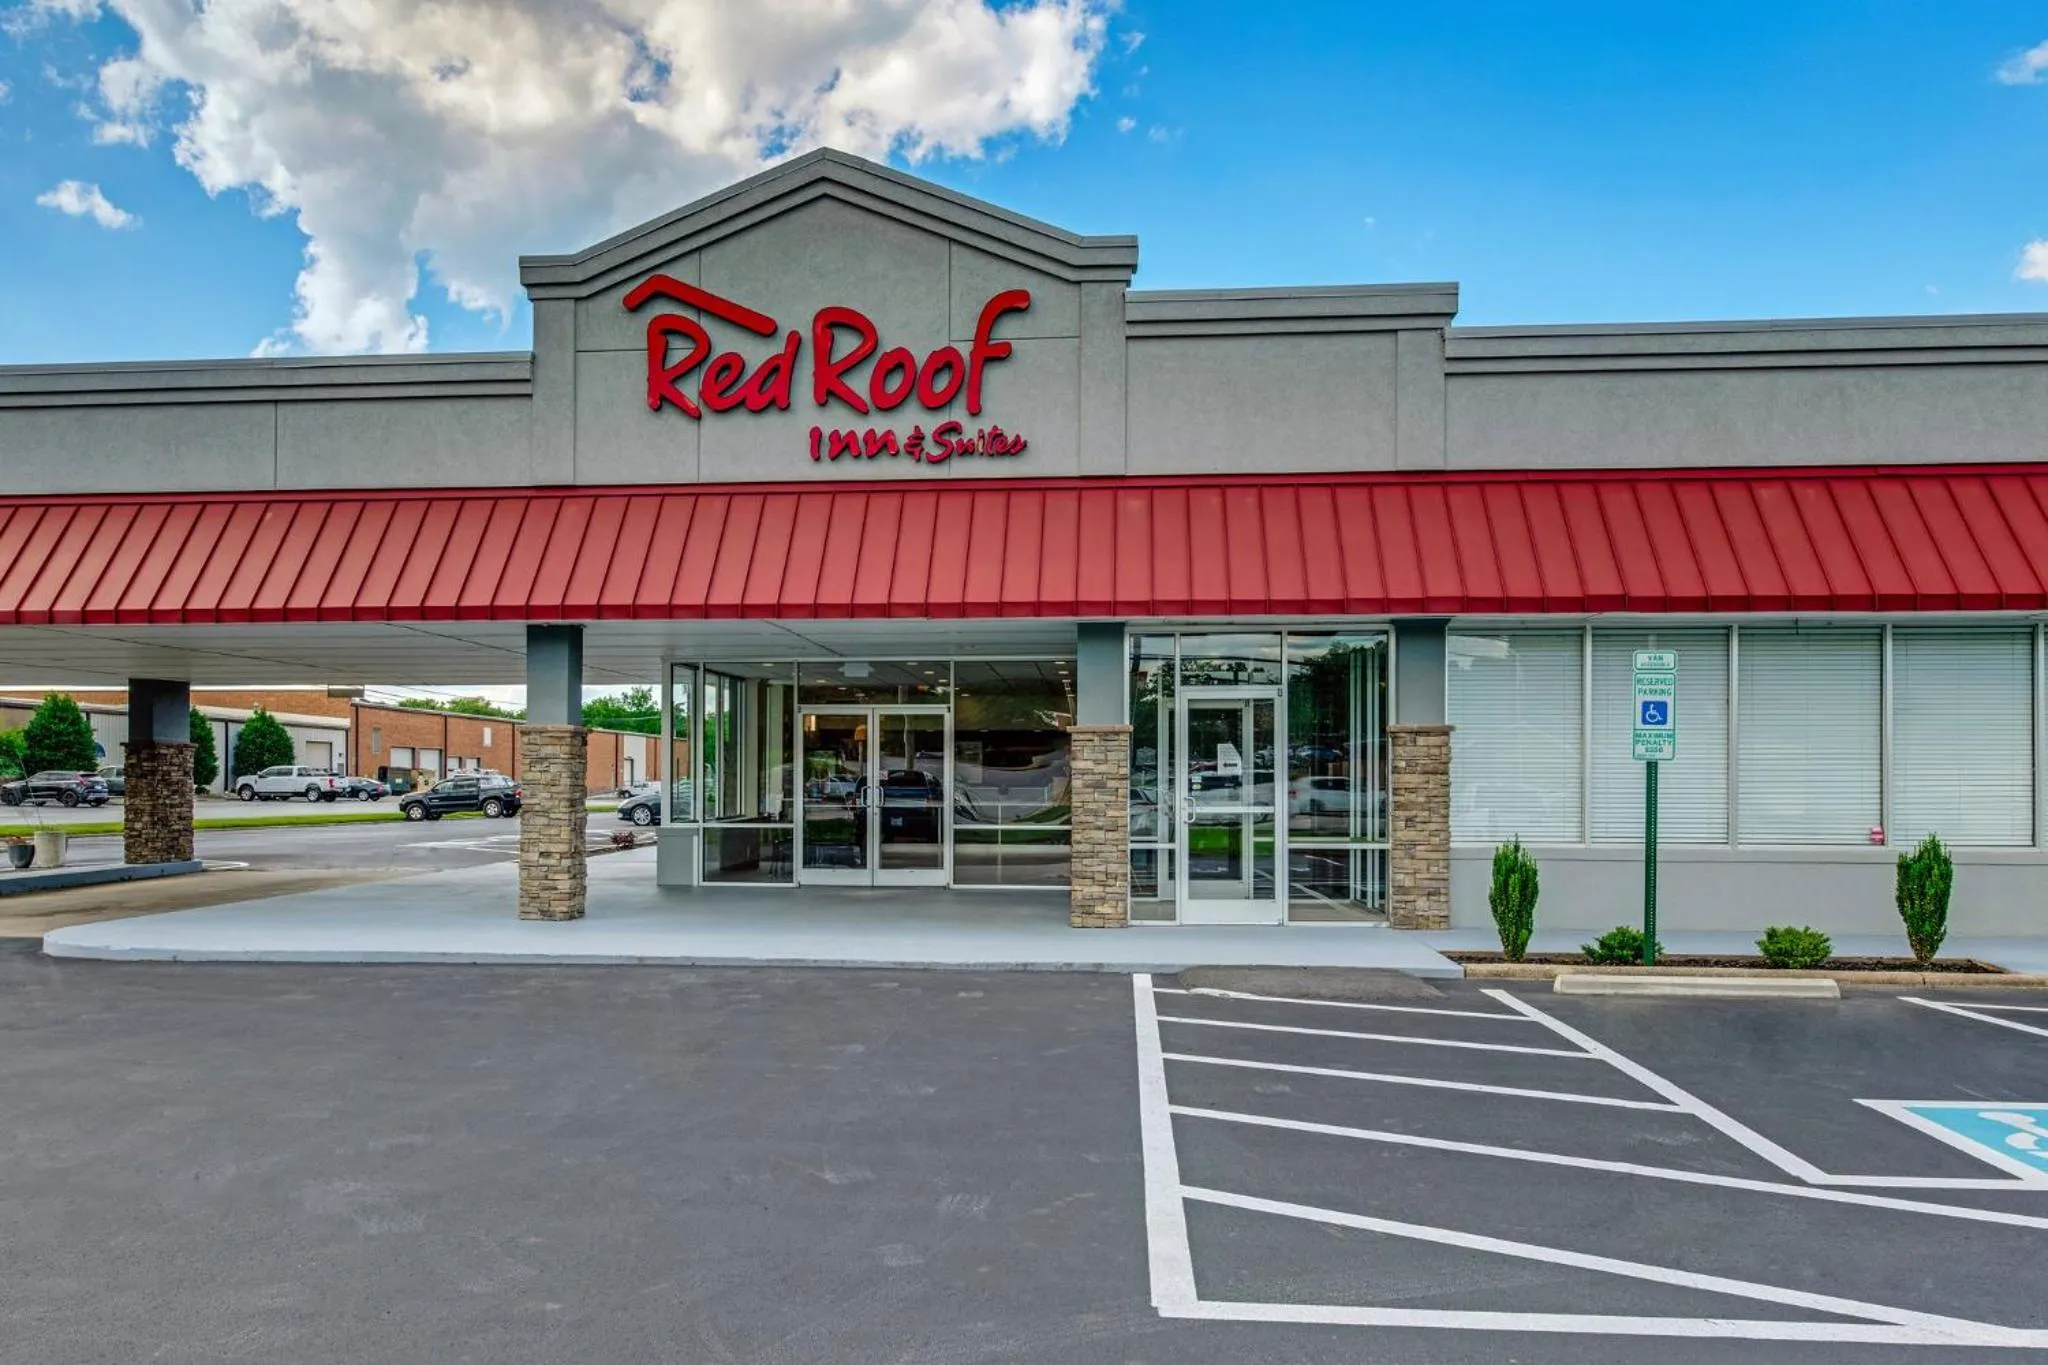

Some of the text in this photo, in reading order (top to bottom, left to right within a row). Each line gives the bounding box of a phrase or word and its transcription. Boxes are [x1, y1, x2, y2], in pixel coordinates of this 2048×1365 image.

[646, 289, 1031, 420] Red Roof
[809, 426, 900, 462] Inn
[925, 420, 1027, 464] Suites
[1636, 677, 1673, 686] RESERVED
[1638, 687, 1672, 696] PARKING
